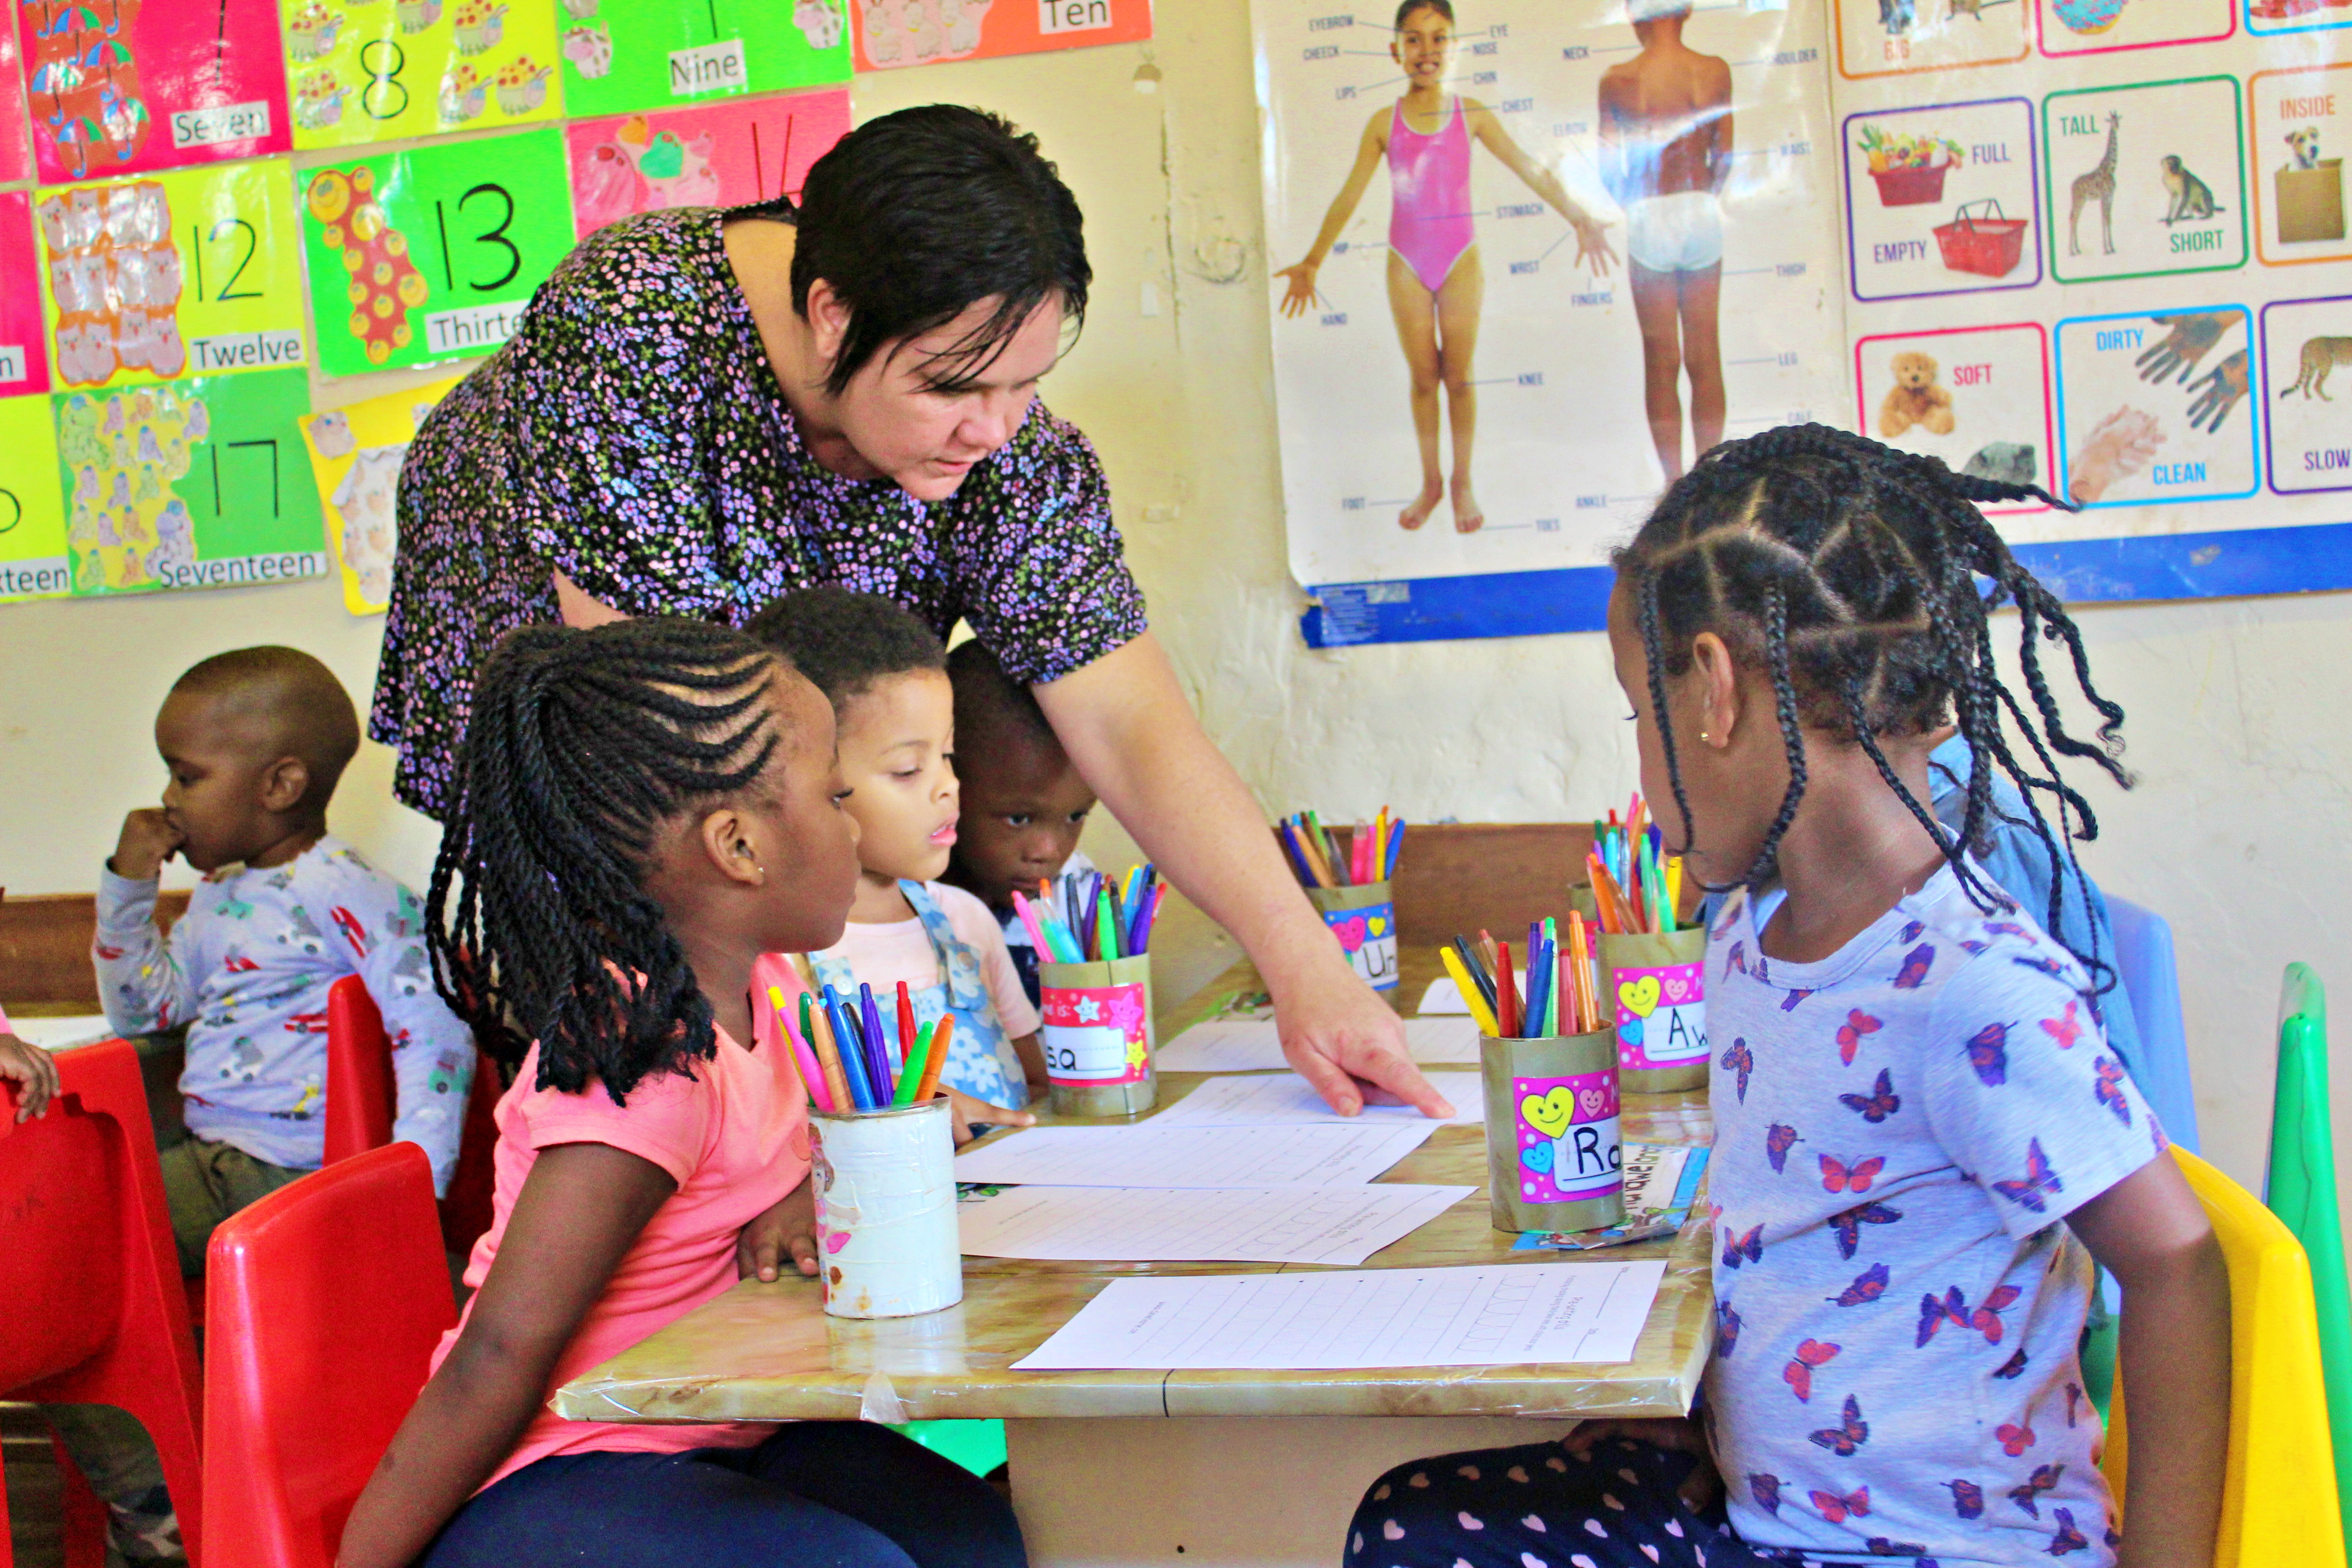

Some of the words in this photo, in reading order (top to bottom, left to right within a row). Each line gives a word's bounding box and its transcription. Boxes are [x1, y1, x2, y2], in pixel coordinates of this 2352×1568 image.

[1043, 0, 1107, 27] Ten
[1309, 15, 1354, 31] EYEBROW
[1490, 24, 1509, 37] EYE
[1472, 42, 1497, 55] NOSE
[1563, 47, 1589, 59] NECK
[1772, 48, 1818, 65] HOULDER
[361, 39, 408, 119] 8
[671, 54, 739, 88] Nine
[1473, 71, 1497, 84] CHIN
[1335, 85, 1357, 99] LIPS
[1502, 98, 1534, 113] CHEST
[2280, 95, 2336, 120] INSIDE
[176, 111, 266, 143] Seven
[2060, 115, 2100, 136] TALL
[1973, 142, 2011, 164] FULL
[1496, 202, 1544, 219] STOMACH
[436, 183, 521, 291] 13
[2170, 230, 2224, 253] SHORT
[194, 219, 264, 302] 12
[1874, 240, 1927, 264] EMPTY
[1509, 260, 1539, 274] WRIST
[1571, 292, 1613, 306] FINGERS
[2097, 328, 2144, 351] DIRTY
[193, 335, 300, 369] Twelve
[1778, 353, 1798, 365] LEG
[1518, 372, 1544, 386] KNEE
[1954, 363, 1992, 386] SOFT
[2304, 448, 2351, 471] SLOW
[212, 440, 279, 519] 17
[2153, 462, 2206, 486] CLEAN
[1343, 497, 1366, 510] FOOT
[1576, 495, 1607, 509] ANKLE
[0, 567, 67, 593] teen
[159, 552, 317, 588] Seventeen
